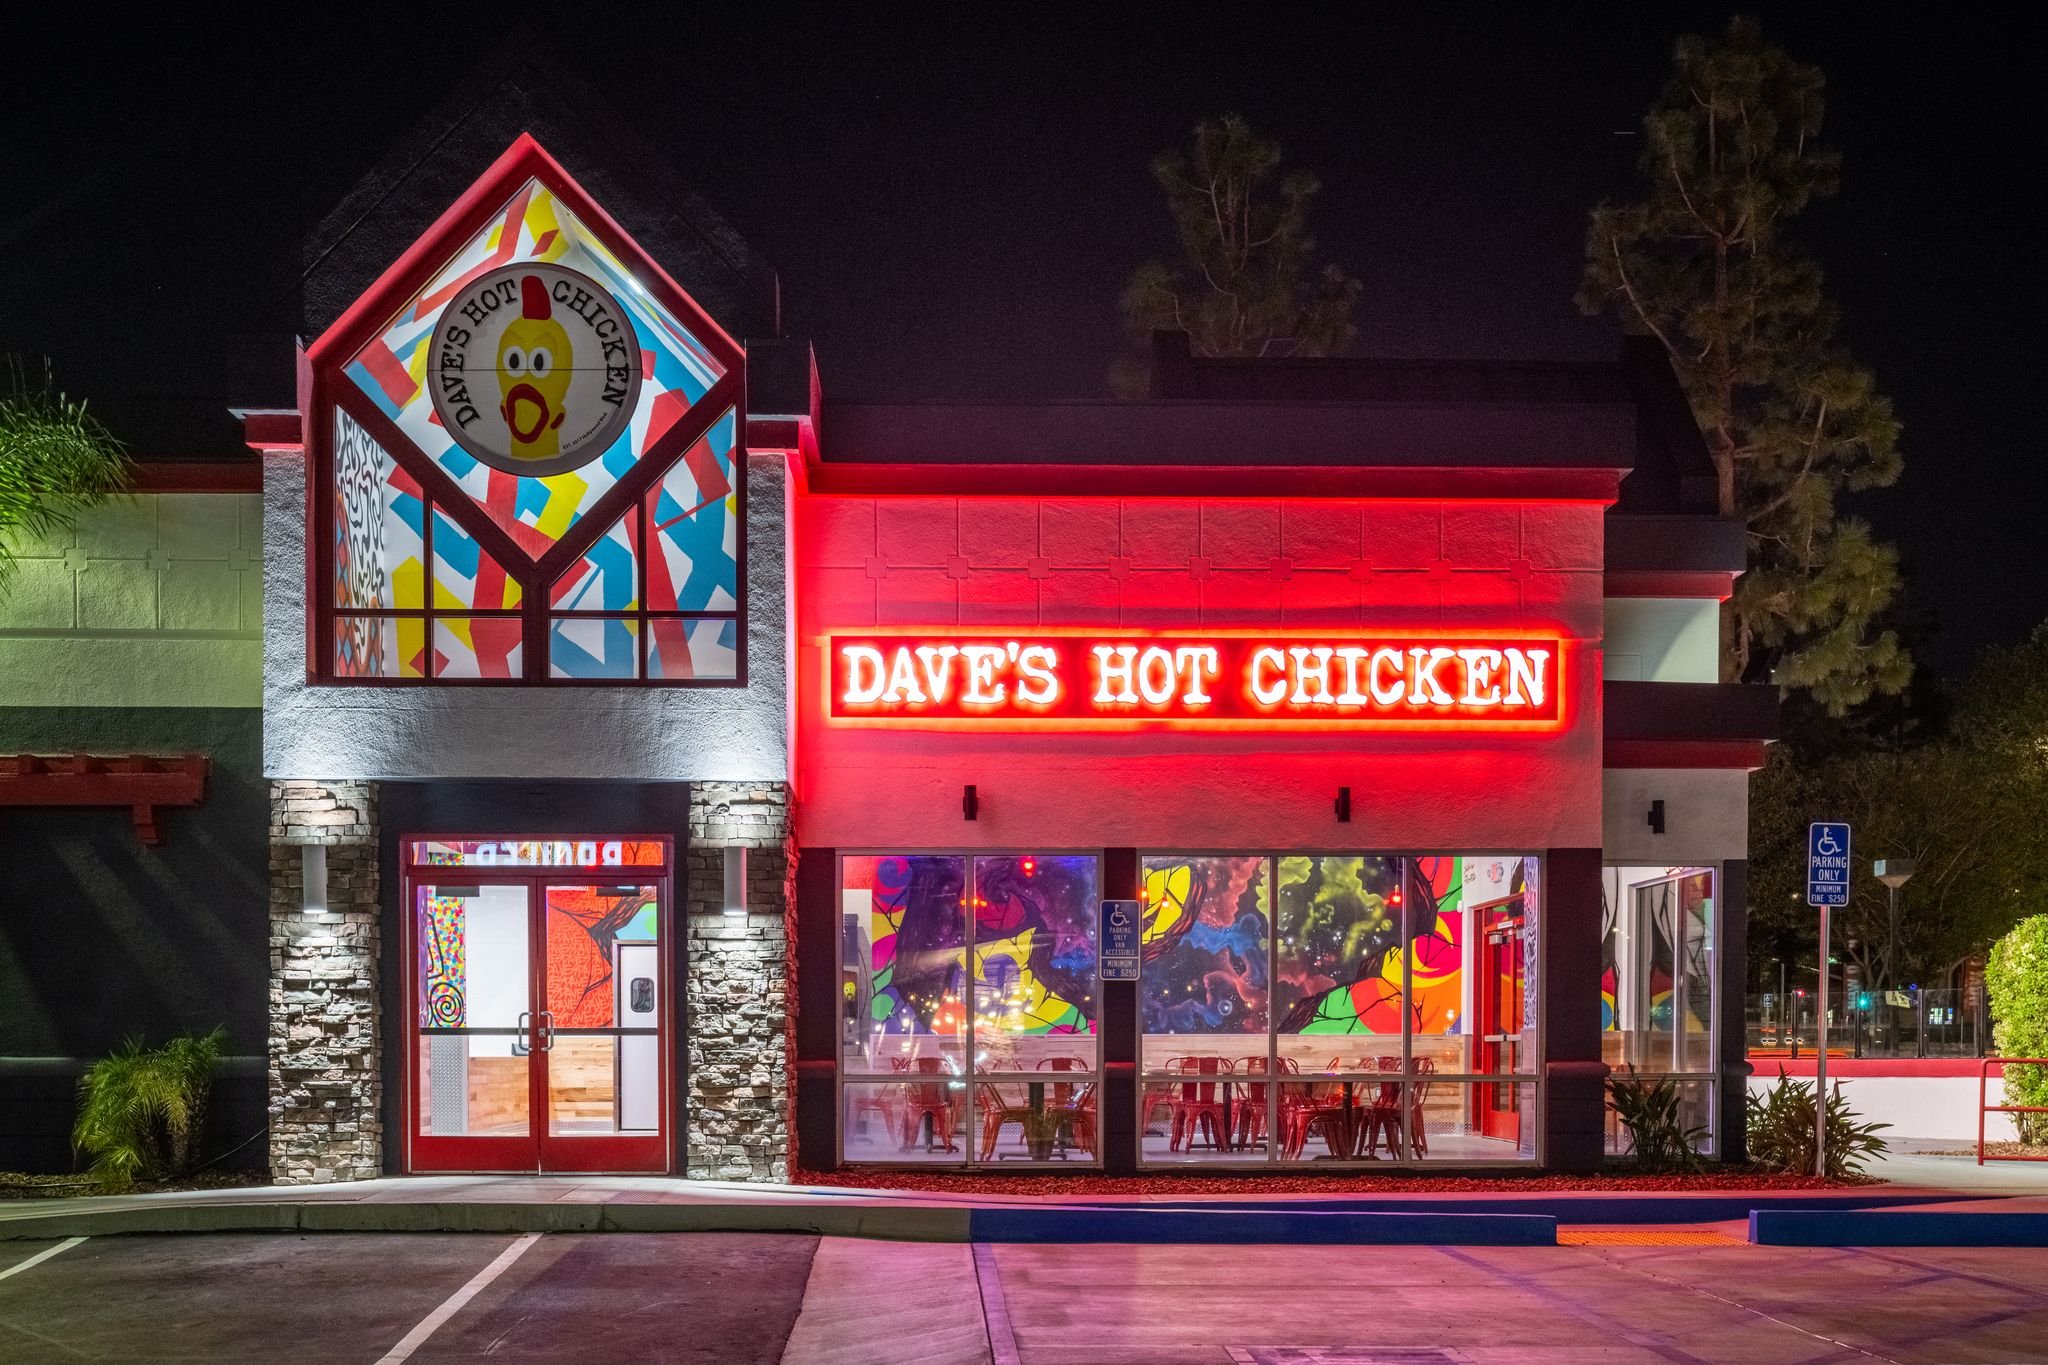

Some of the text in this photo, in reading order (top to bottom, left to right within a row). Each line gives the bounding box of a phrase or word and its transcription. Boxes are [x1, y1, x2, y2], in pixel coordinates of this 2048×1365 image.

[441, 279, 629, 429] DAVE'S HOT CHICKEN
[842, 641, 1551, 708] DAVE'S HOT CHICKEN
[1812, 856, 1847, 868] PARKING
[1818, 869, 1840, 881] ONLY
[1815, 885, 1841, 893] MINIMUM
[1811, 894, 1824, 902] FINE
[1109, 926, 1132, 934] PARKING
[1107, 960, 1133, 968] MINIMUM
[1103, 969, 1116, 977] FINE
